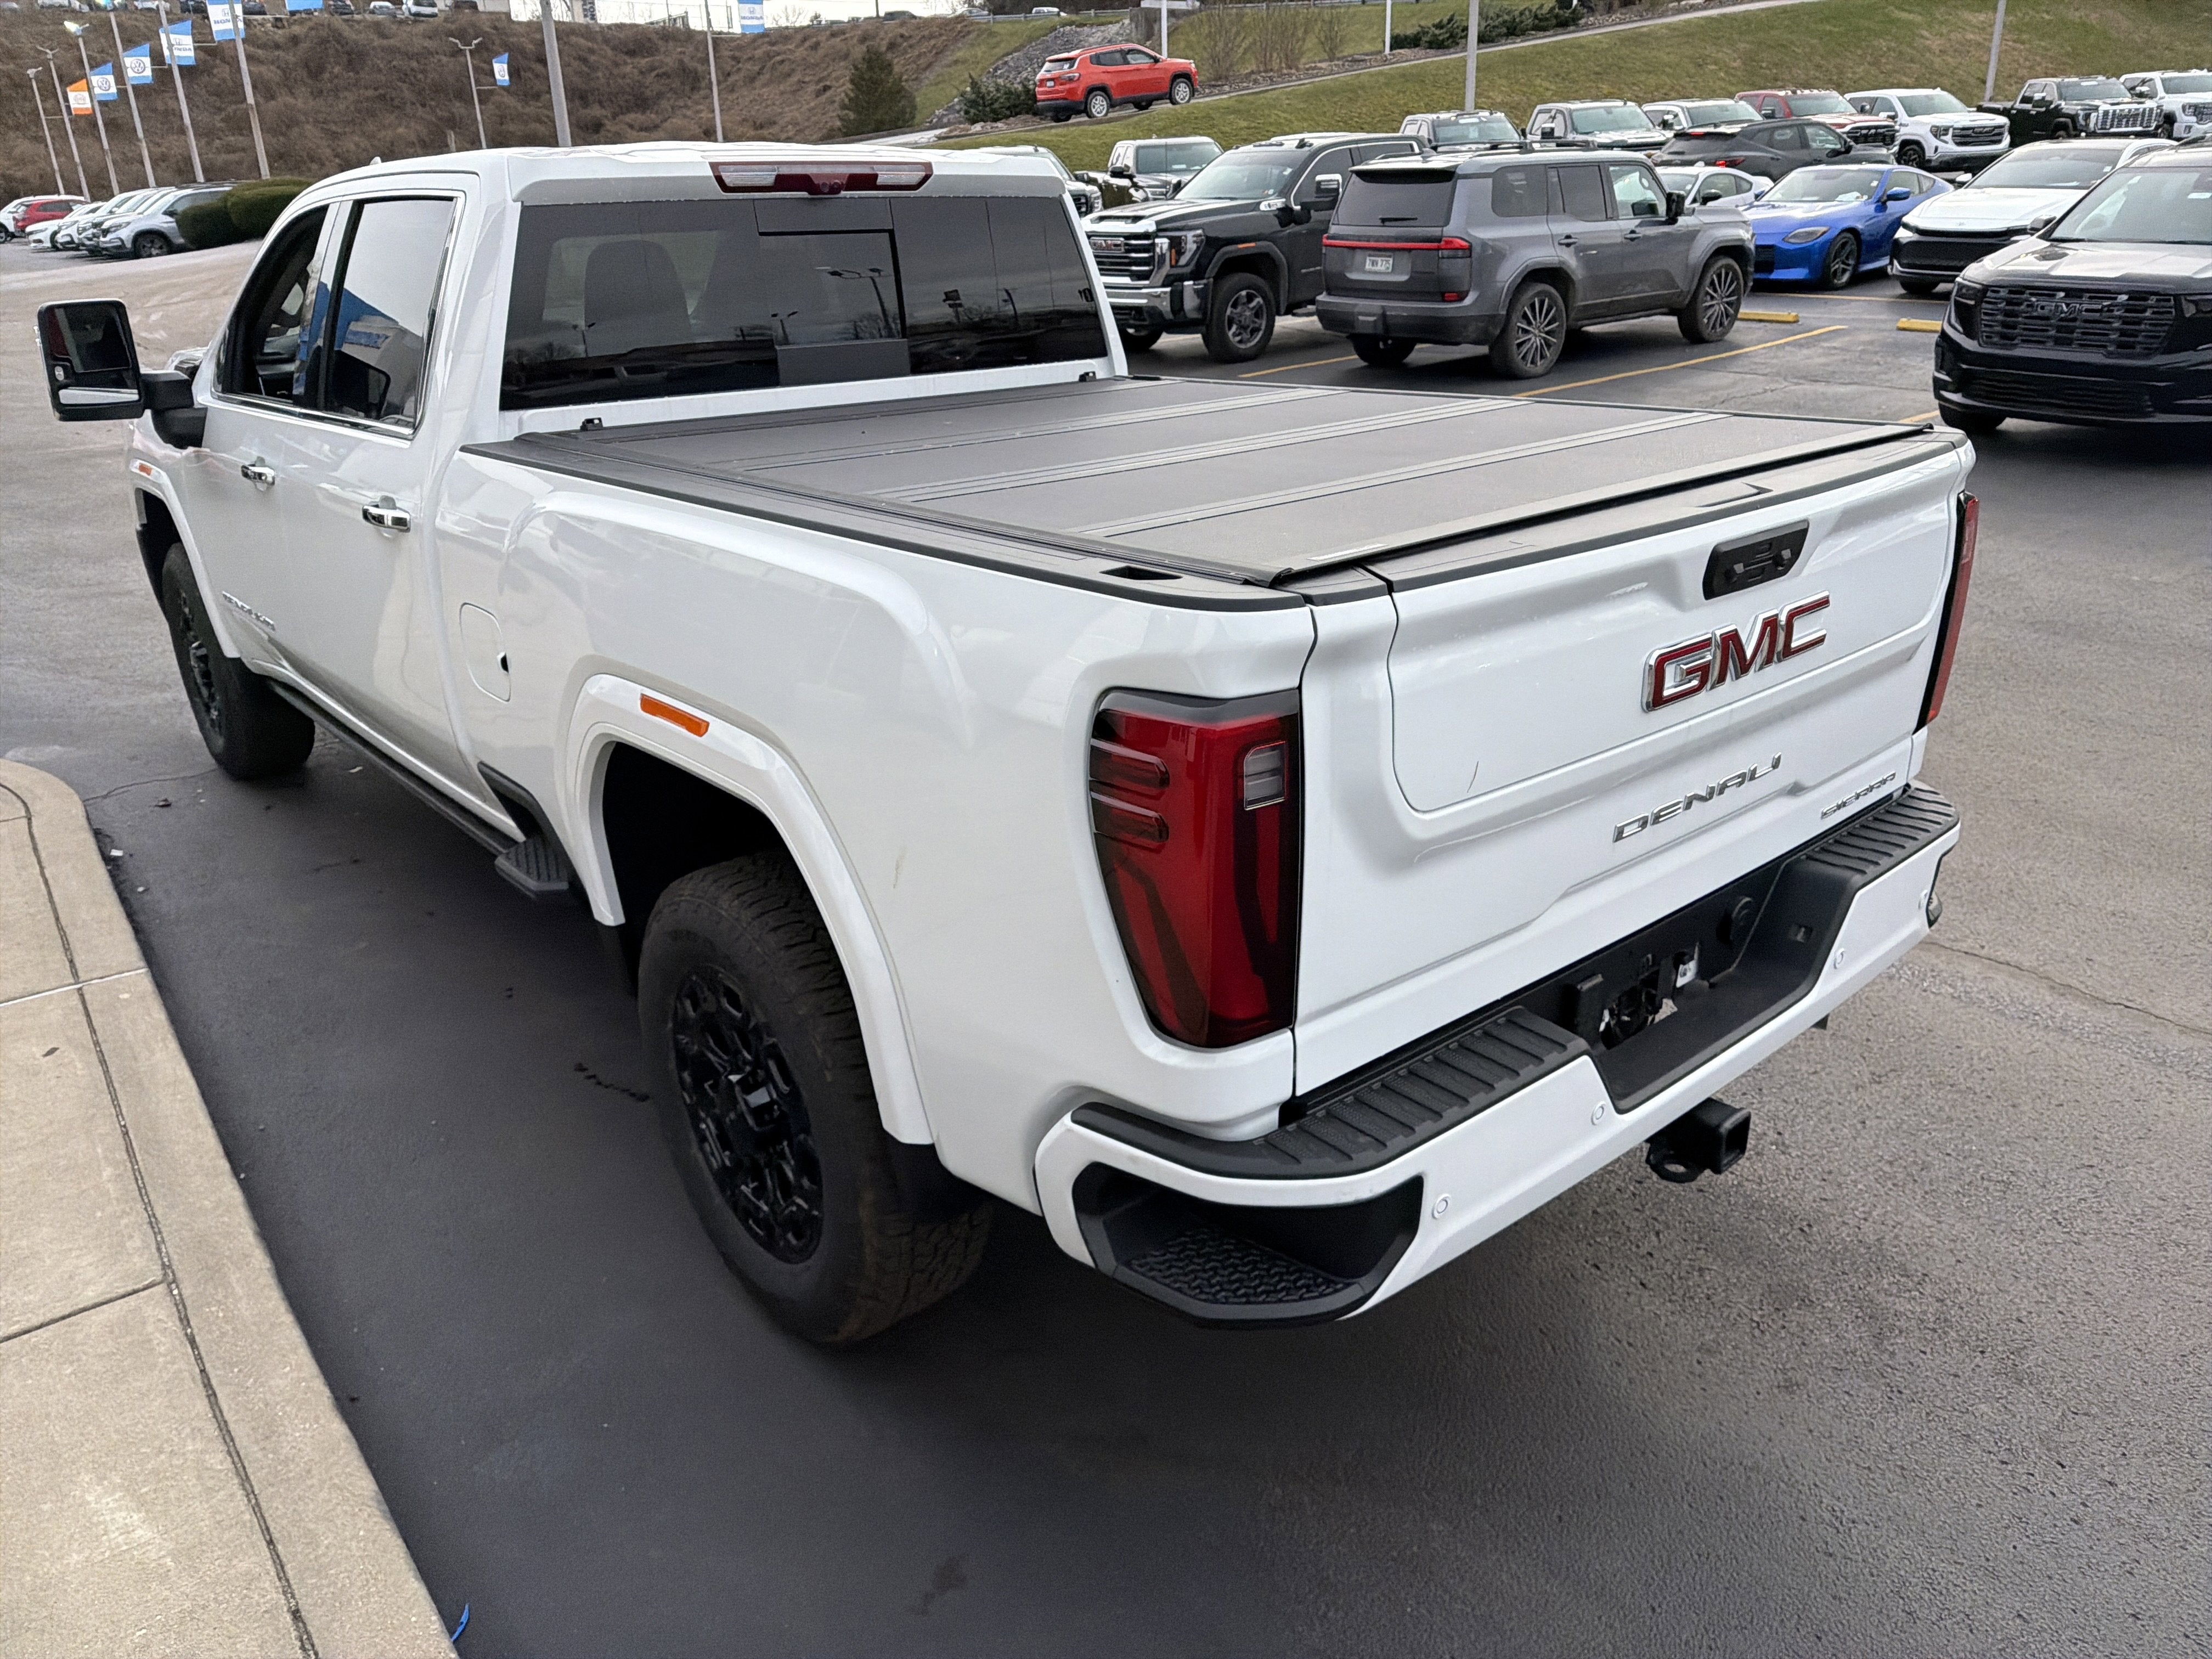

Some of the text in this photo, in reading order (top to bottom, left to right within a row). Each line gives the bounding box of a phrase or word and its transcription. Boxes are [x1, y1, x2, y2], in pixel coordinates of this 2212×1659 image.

[1641, 590, 1830, 713] GMC
[1612, 752, 1781, 843] DENALI
[1821, 771, 1897, 820] SIERRA
